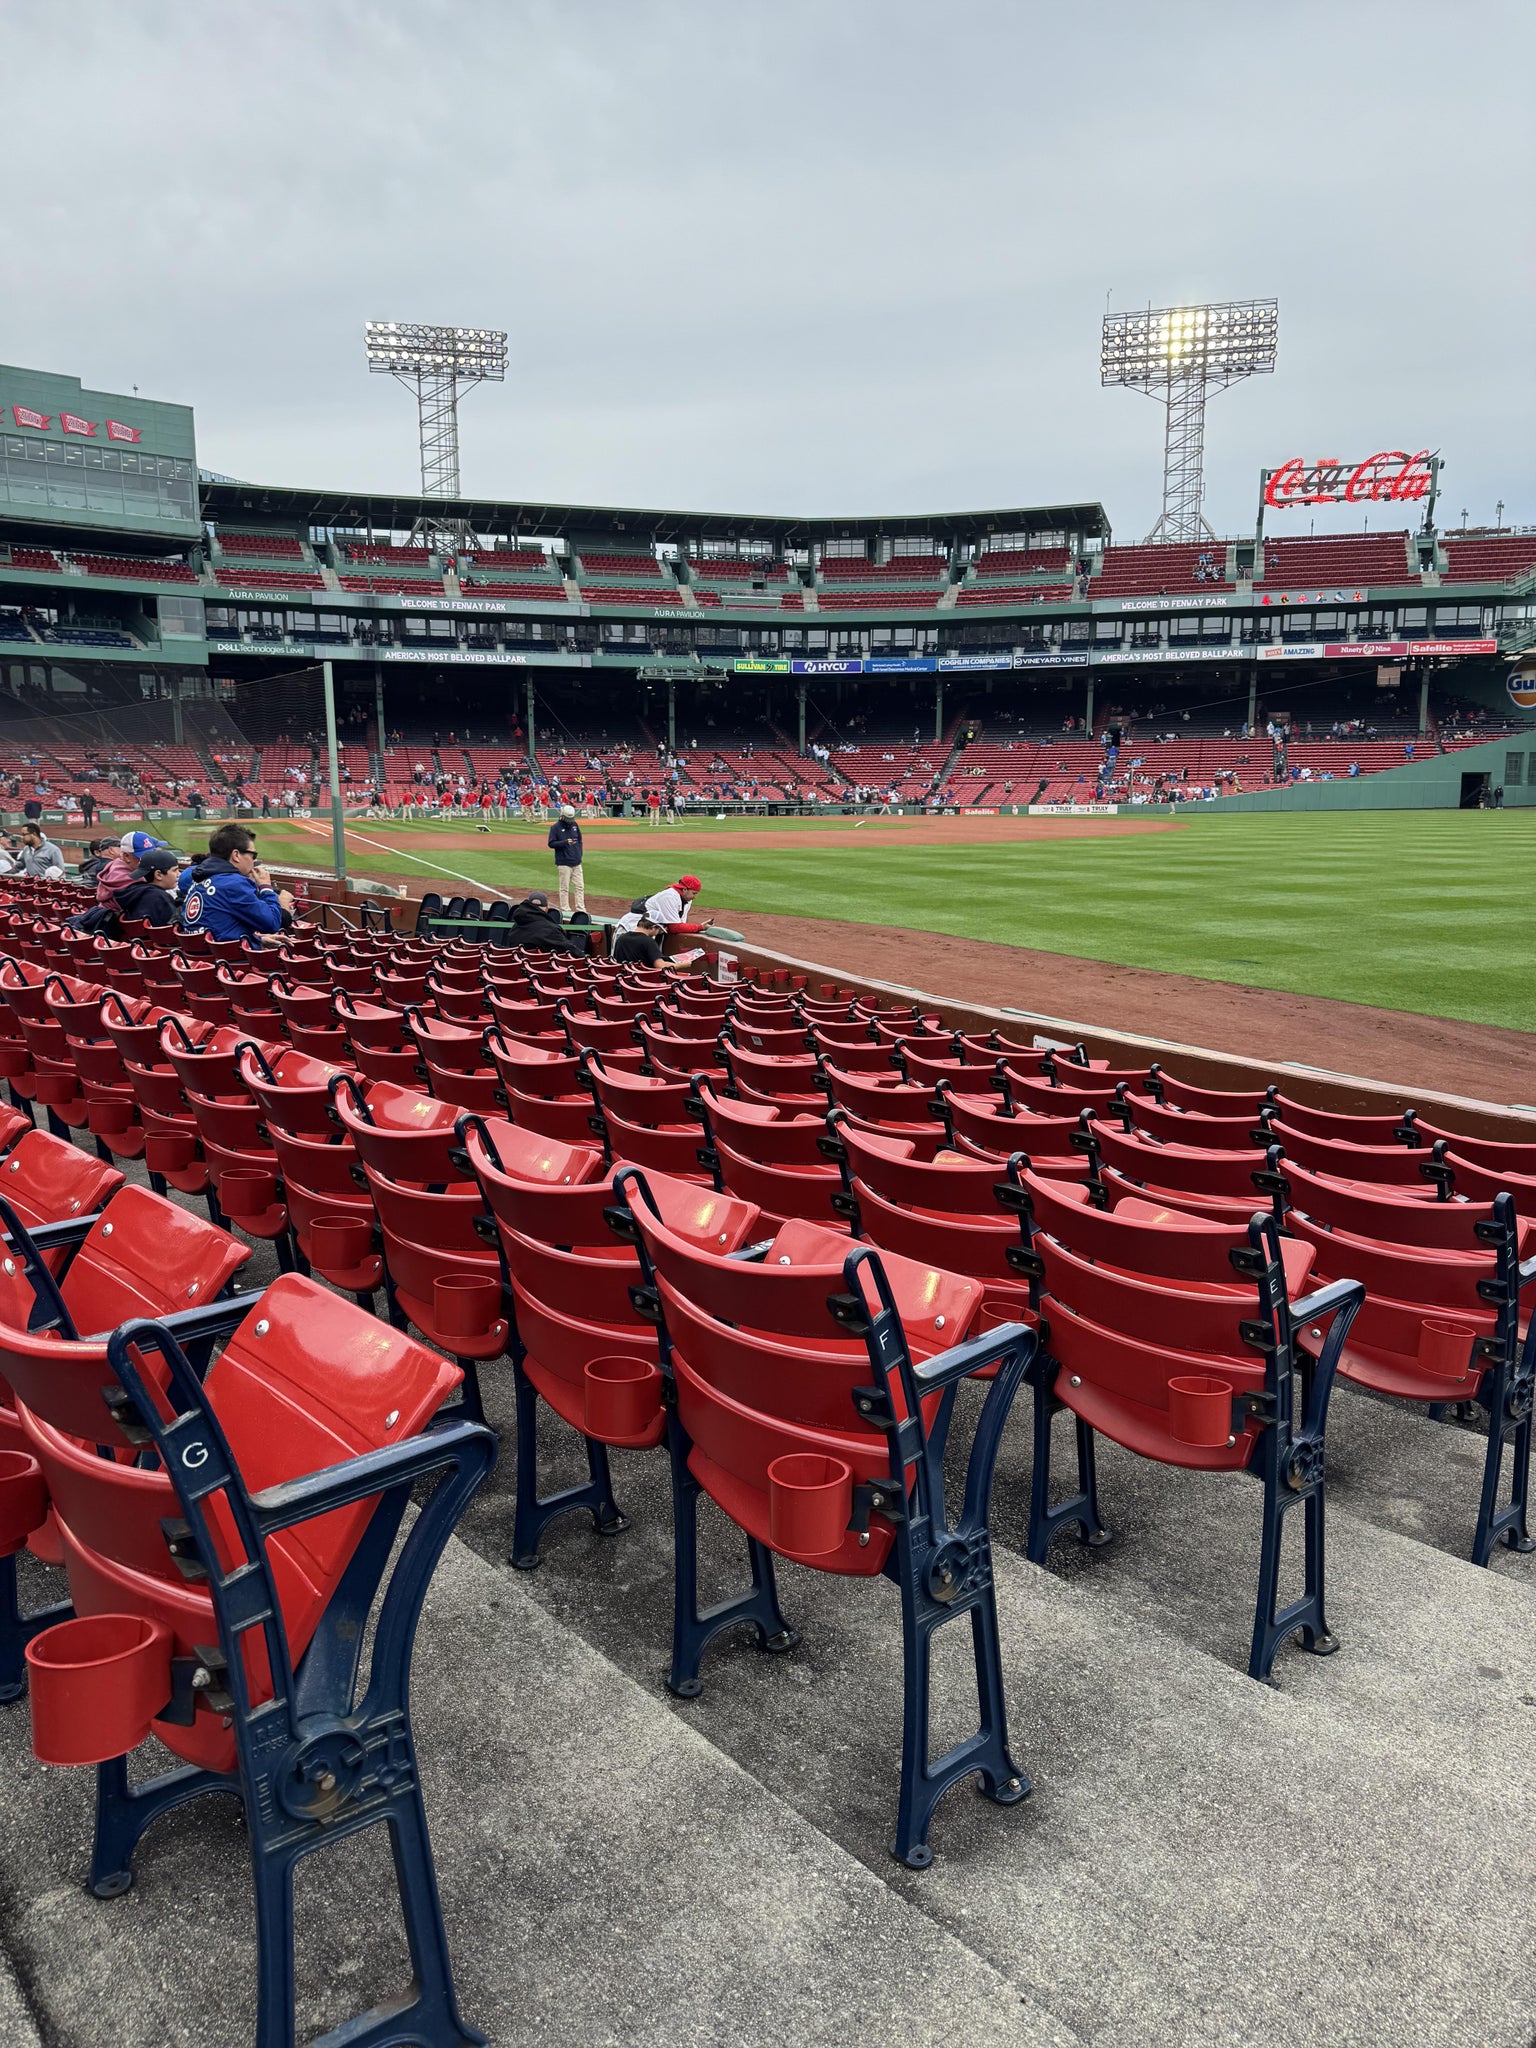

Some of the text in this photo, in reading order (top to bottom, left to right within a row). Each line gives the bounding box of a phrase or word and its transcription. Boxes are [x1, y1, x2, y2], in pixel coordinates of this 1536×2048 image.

[255, 592, 289, 601] PAVILION
[401, 599, 506, 611] WELCOME TO FENWAY PARK
[1121, 597, 1227, 610] WELCOME TO FENWAY PARK
[677, 610, 705, 618] PAVILION
[217, 643, 305, 655] DELL Technologies Level
[1412, 644, 1452, 653] Safelite
[385, 651, 527, 664] AMERICA'S MOST BELOVED BALLPARK
[940, 658, 969, 666] COGHLIN
[970, 657, 1011, 665] COMPANIES
[1022, 657, 1061, 665] VINEYARD
[1101, 650, 1244, 662] AMERICA'S MOST BELOVED BALLPARK
[737, 662, 765, 671] SULLIVAN
[818, 662, 848, 671] HYCU
[1508, 674, 1536, 691] Gu
[1269, 1278, 1278, 1295] E
[878, 1328, 890, 1351] F
[181, 1441, 209, 1468] G
